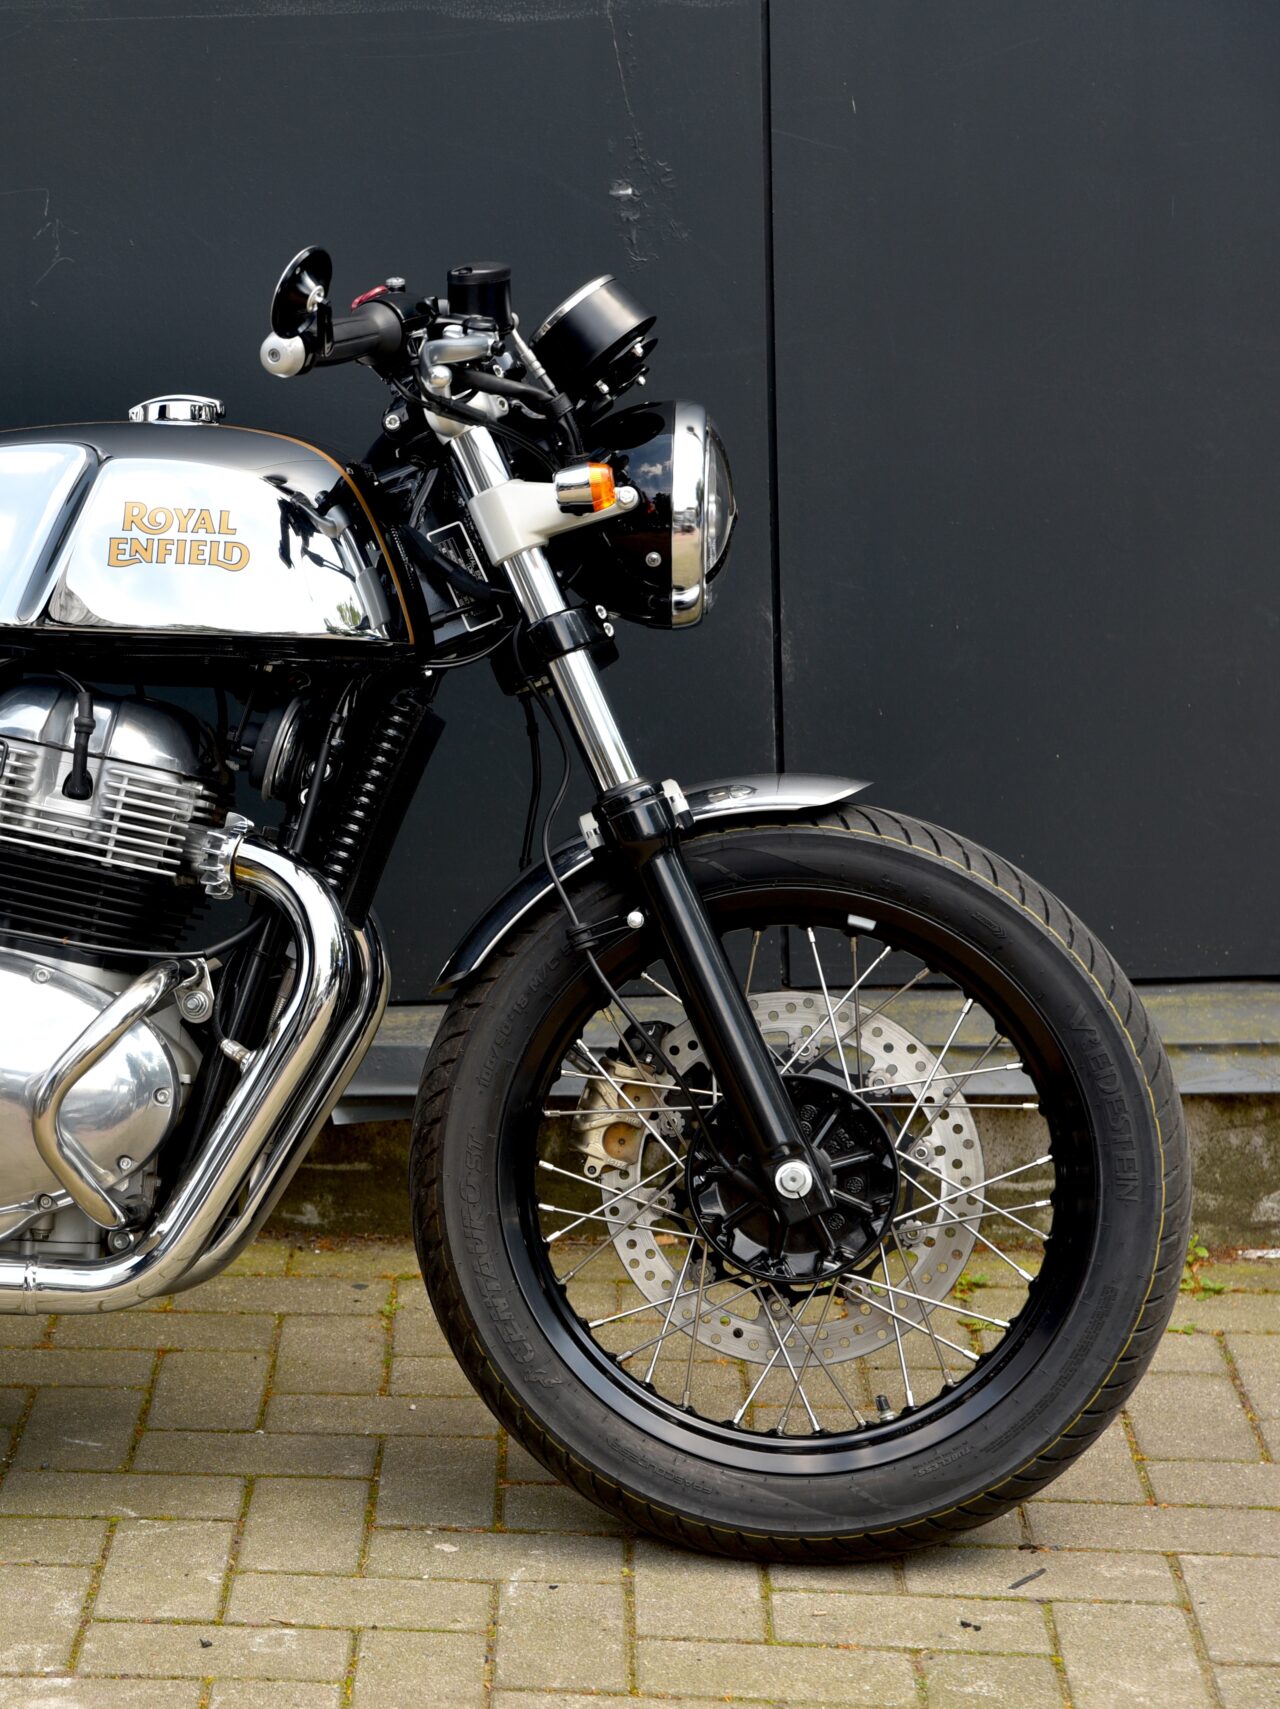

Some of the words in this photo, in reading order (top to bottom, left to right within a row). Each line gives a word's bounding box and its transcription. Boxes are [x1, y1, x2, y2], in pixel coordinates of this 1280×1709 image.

[122, 501, 237, 535] ROYAL
[107, 537, 251, 572] ENFIELD
[1068, 1001, 1140, 1204] VREDESTEIN
[464, 1134, 485, 1173] ST
[459, 1175, 536, 1364] CENTAURO
